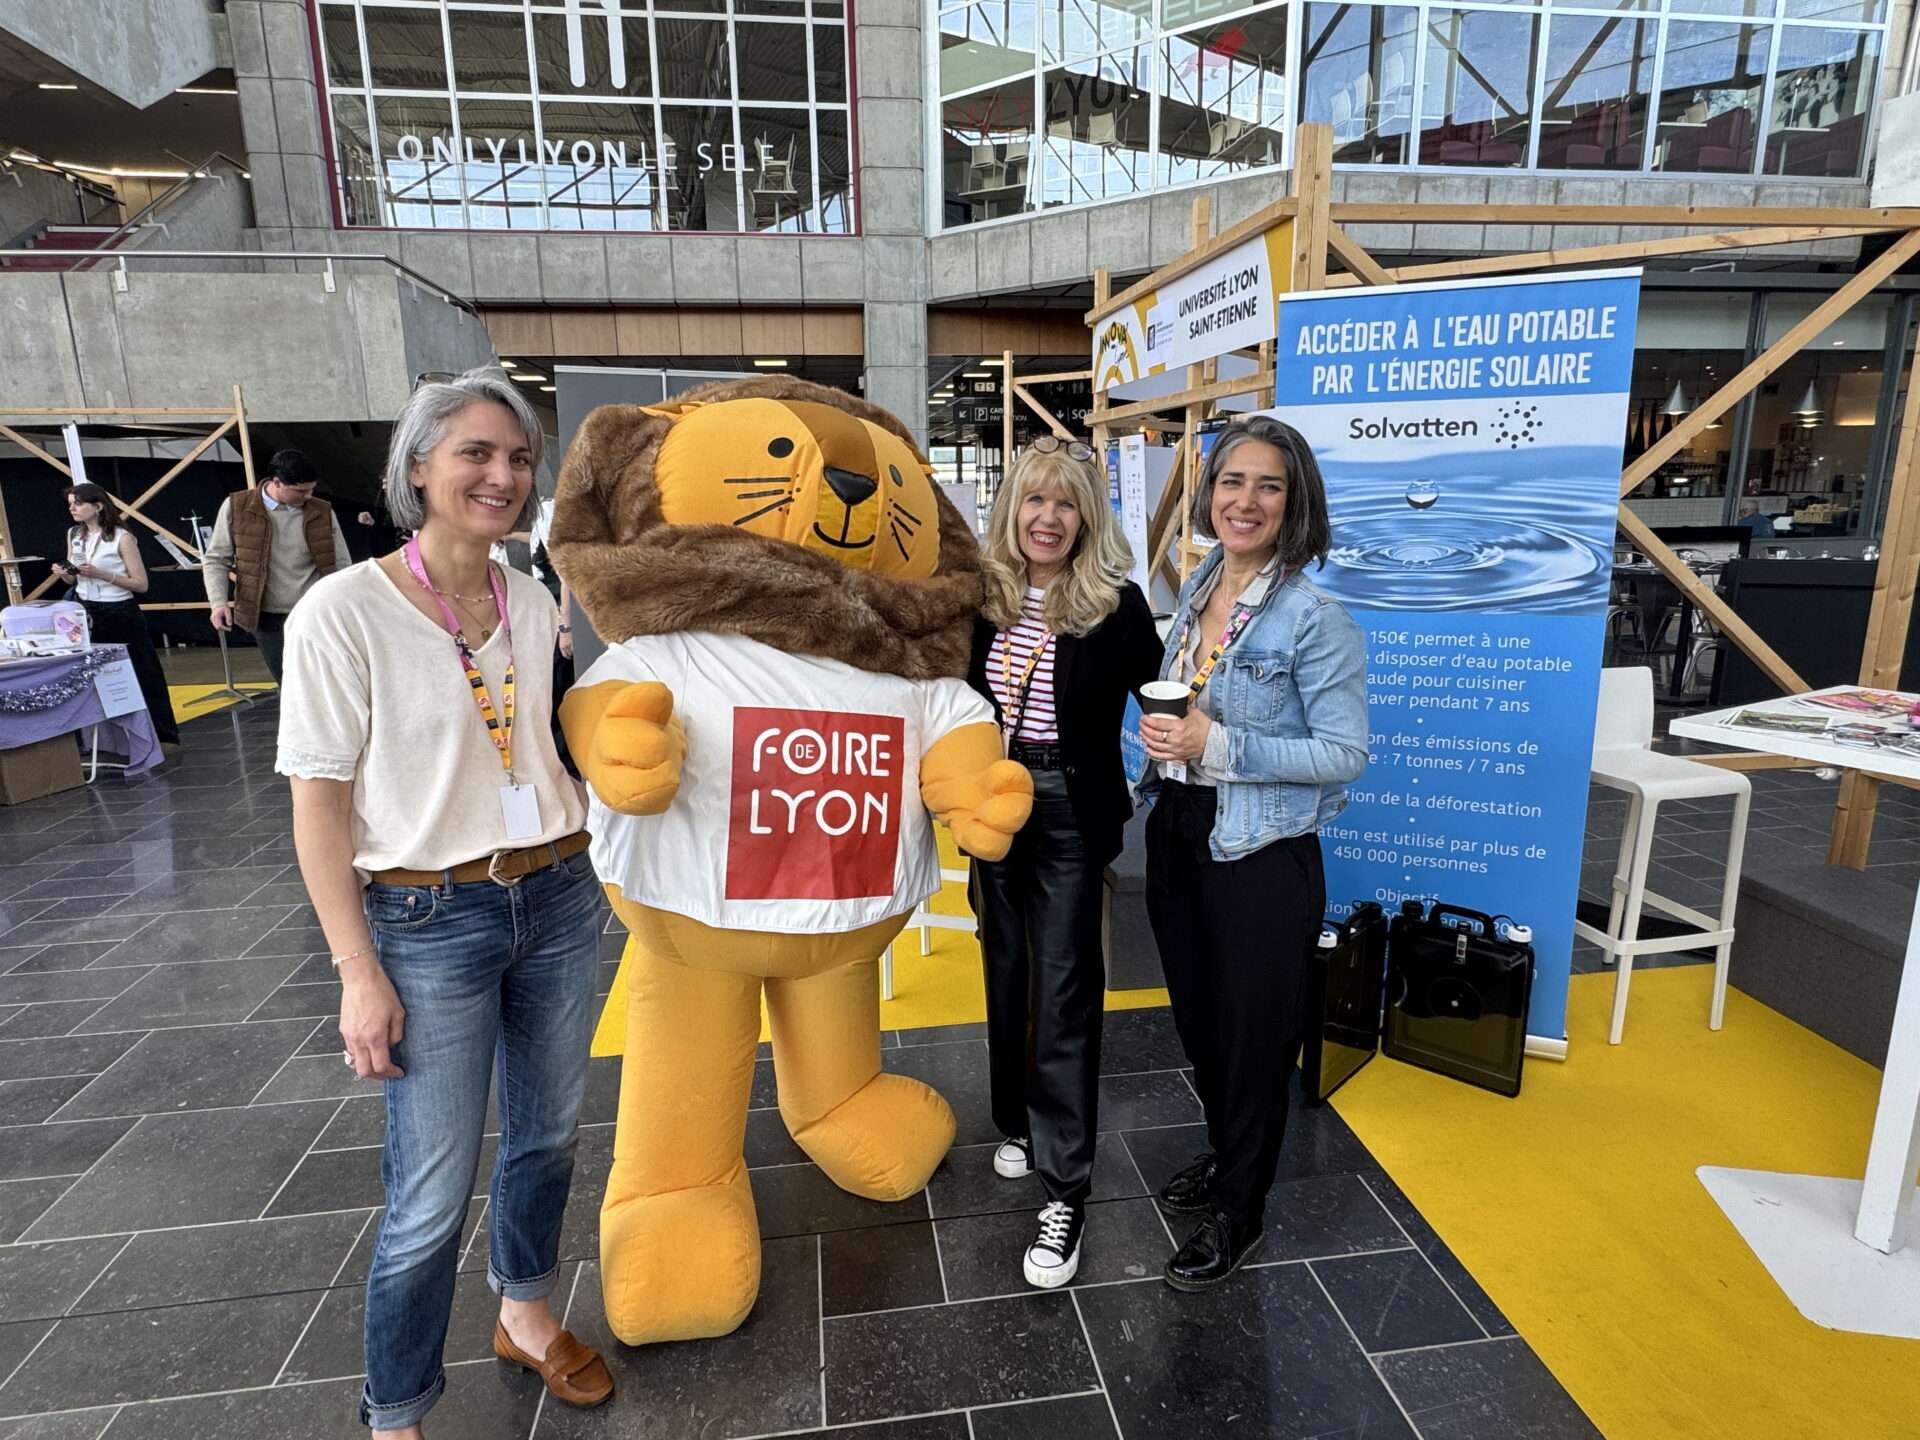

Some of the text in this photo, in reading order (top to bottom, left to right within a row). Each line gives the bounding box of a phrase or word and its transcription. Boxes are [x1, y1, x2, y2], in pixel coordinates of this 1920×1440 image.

[640, 140, 677, 170] LE
[696, 142, 775, 172] SELF
[1178, 265, 1259, 318] UNIVERSITÉ LYON
[1189, 295, 1258, 340] SAINT-ETIENNE
[1296, 307, 1617, 355] ACCÉDER À L'EAU POTABLE
[1313, 353, 1593, 395] PAR L'ÉNERGIE SOLAIRE
[1349, 417, 1478, 439] Solvatten
[1370, 630, 1530, 649] 150€ permet à une
[1375, 650, 1572, 673] disposer d'eau potable
[1367, 671, 1526, 691] aude pour cuisiner
[1367, 694, 1530, 713] aver pendant 7 ans
[752, 727, 891, 777] FOIRE
[795, 743, 815, 760] DE
[1391, 733, 1420, 748] des
[1425, 735, 1511, 754] émissions
[1517, 740, 1539, 756] de
[1393, 752, 1401, 767] 7
[1406, 754, 1463, 771] tonnes
[1468, 758, 1477, 774] /
[1481, 758, 1490, 772] 7
[1494, 762, 1526, 776] ans
[749, 788, 889, 836] LYON
[1343, 789, 1542, 818] tion de la déforestation
[1317, 825, 1547, 860] atten est utilisé par plus de
[1333, 845, 1488, 874] 450 000 personnes
